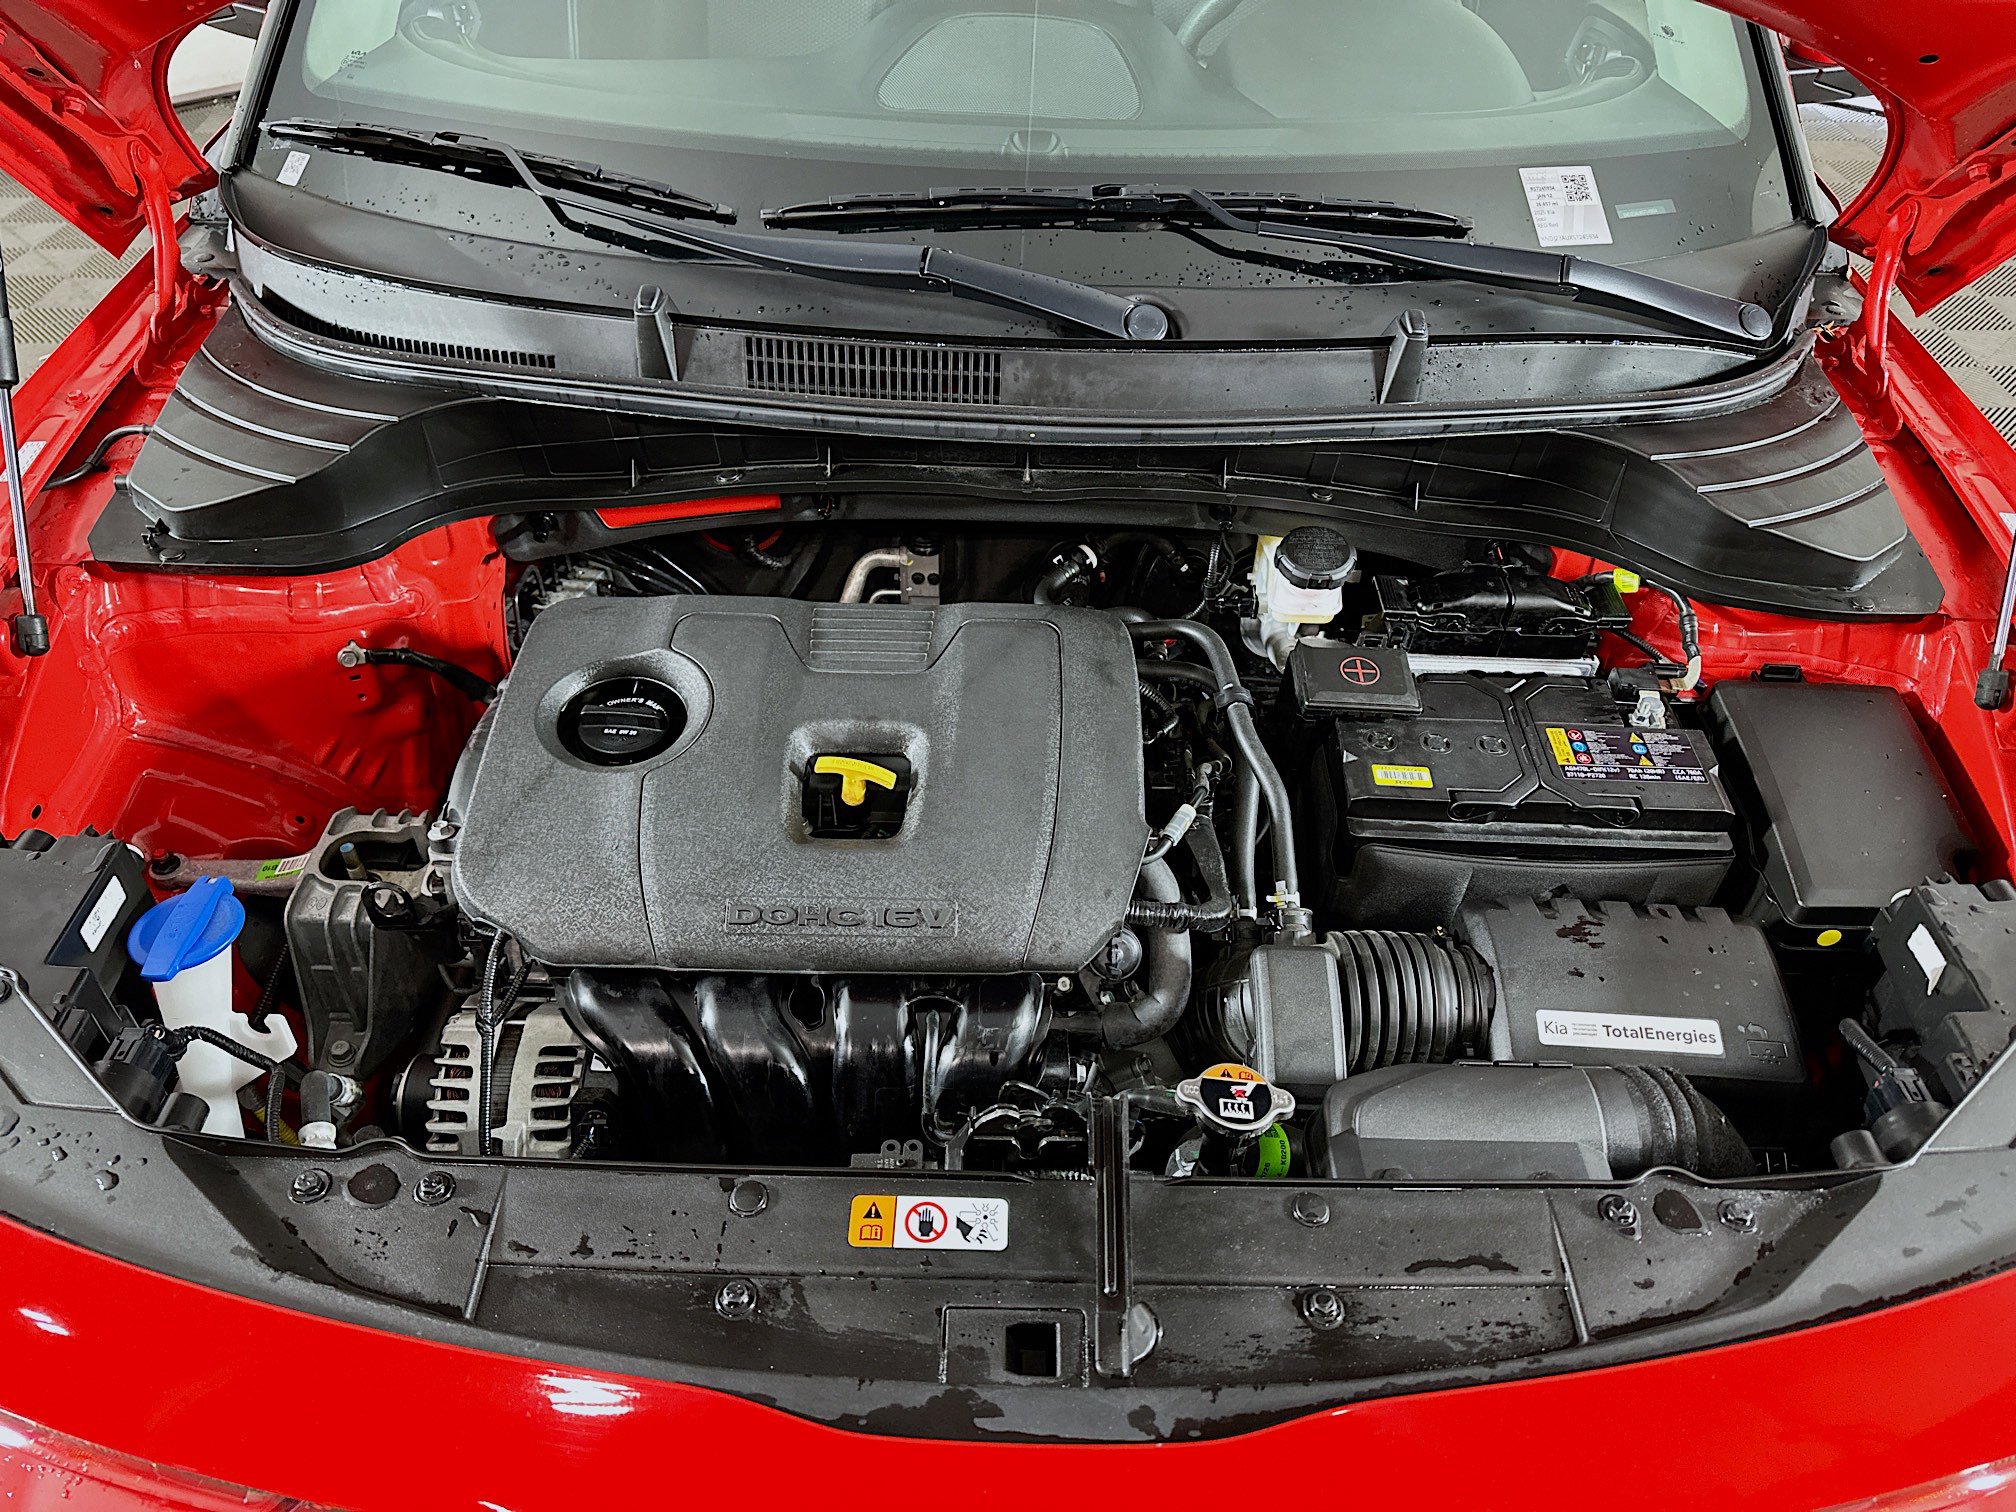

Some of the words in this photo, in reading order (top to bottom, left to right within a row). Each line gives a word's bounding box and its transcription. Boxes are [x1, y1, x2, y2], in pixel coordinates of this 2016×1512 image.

[606, 697, 645, 707] OWNER'S
[726, 904, 866, 928] DOHC
[873, 906, 953, 930] 16V
[1543, 1020, 1568, 1035] Kia
[1602, 1024, 1717, 1045] TotalEnergies
[1184, 1085, 1199, 1094] DCC
